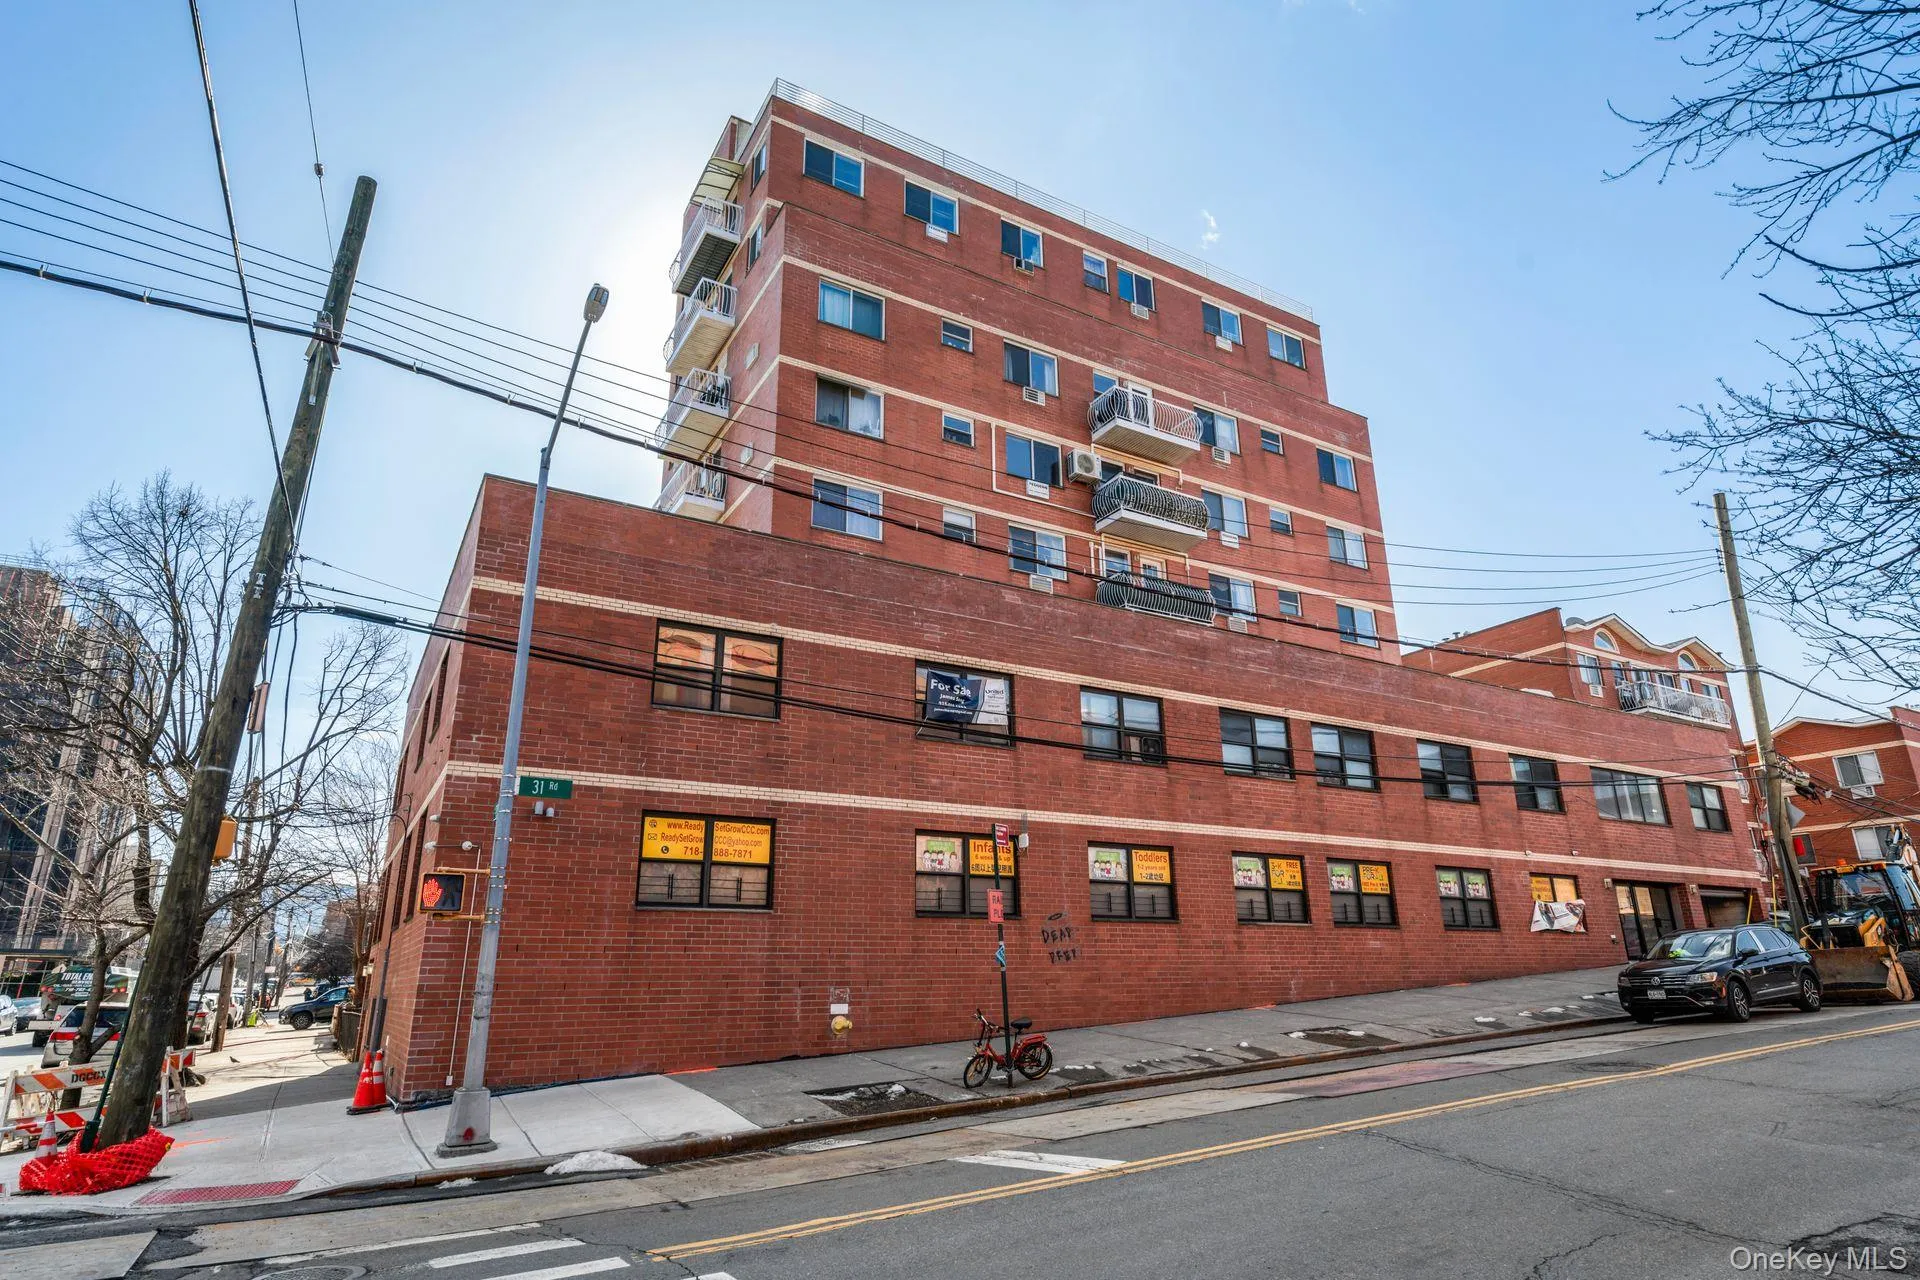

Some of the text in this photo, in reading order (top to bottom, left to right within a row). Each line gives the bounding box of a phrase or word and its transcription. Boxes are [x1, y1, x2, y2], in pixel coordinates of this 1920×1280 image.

[930, 678, 950, 692] For
[532, 780, 559, 794] 31 Rd
[667, 821, 770, 836] www.Ready SetGrowCCC.com
[660, 831, 763, 848] ReadySetGrow CCC@yahoo.com
[1134, 851, 1168, 864] Toddlers
[1286, 861, 1299, 869] FREE
[60, 972, 81, 981] TOTAL
